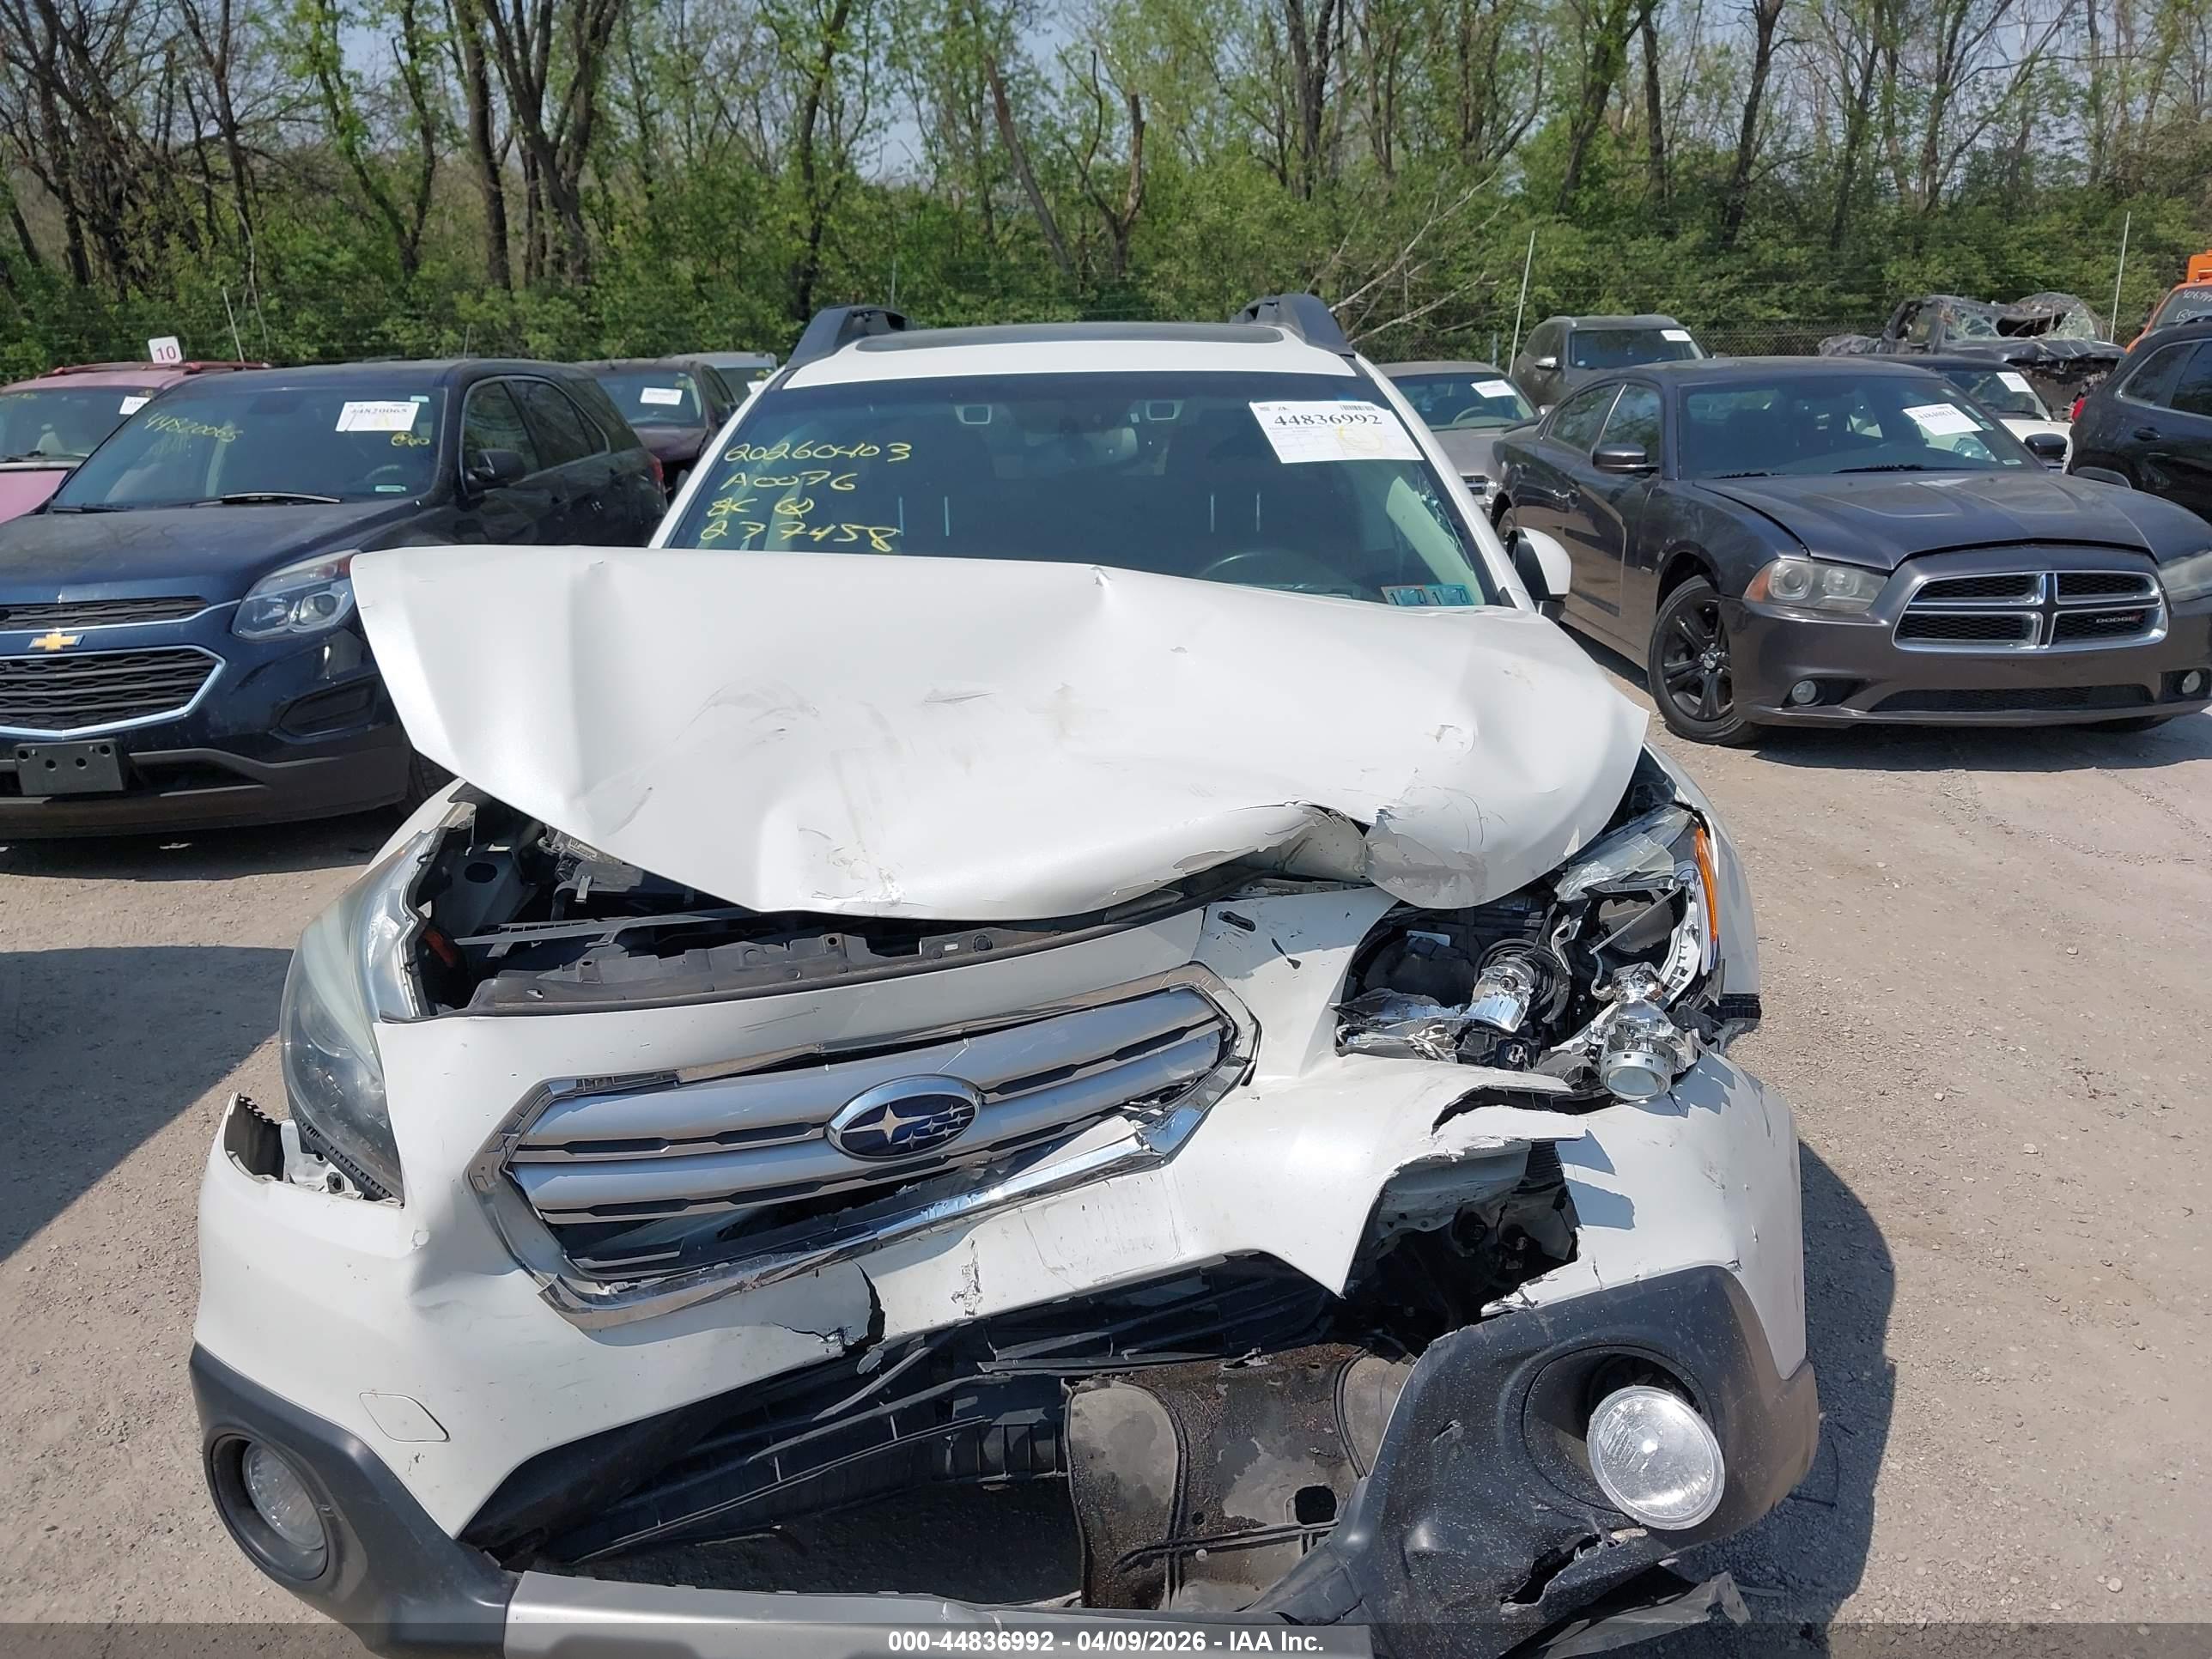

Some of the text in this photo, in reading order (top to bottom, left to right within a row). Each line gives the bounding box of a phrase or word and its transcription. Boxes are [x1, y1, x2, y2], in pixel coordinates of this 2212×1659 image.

[156, 345, 177, 361] 10
[1274, 413, 1383, 426] 44836992
[724, 440, 913, 463] 20260403
[719, 471, 859, 491] A0076
[700, 520, 903, 552] 277458
